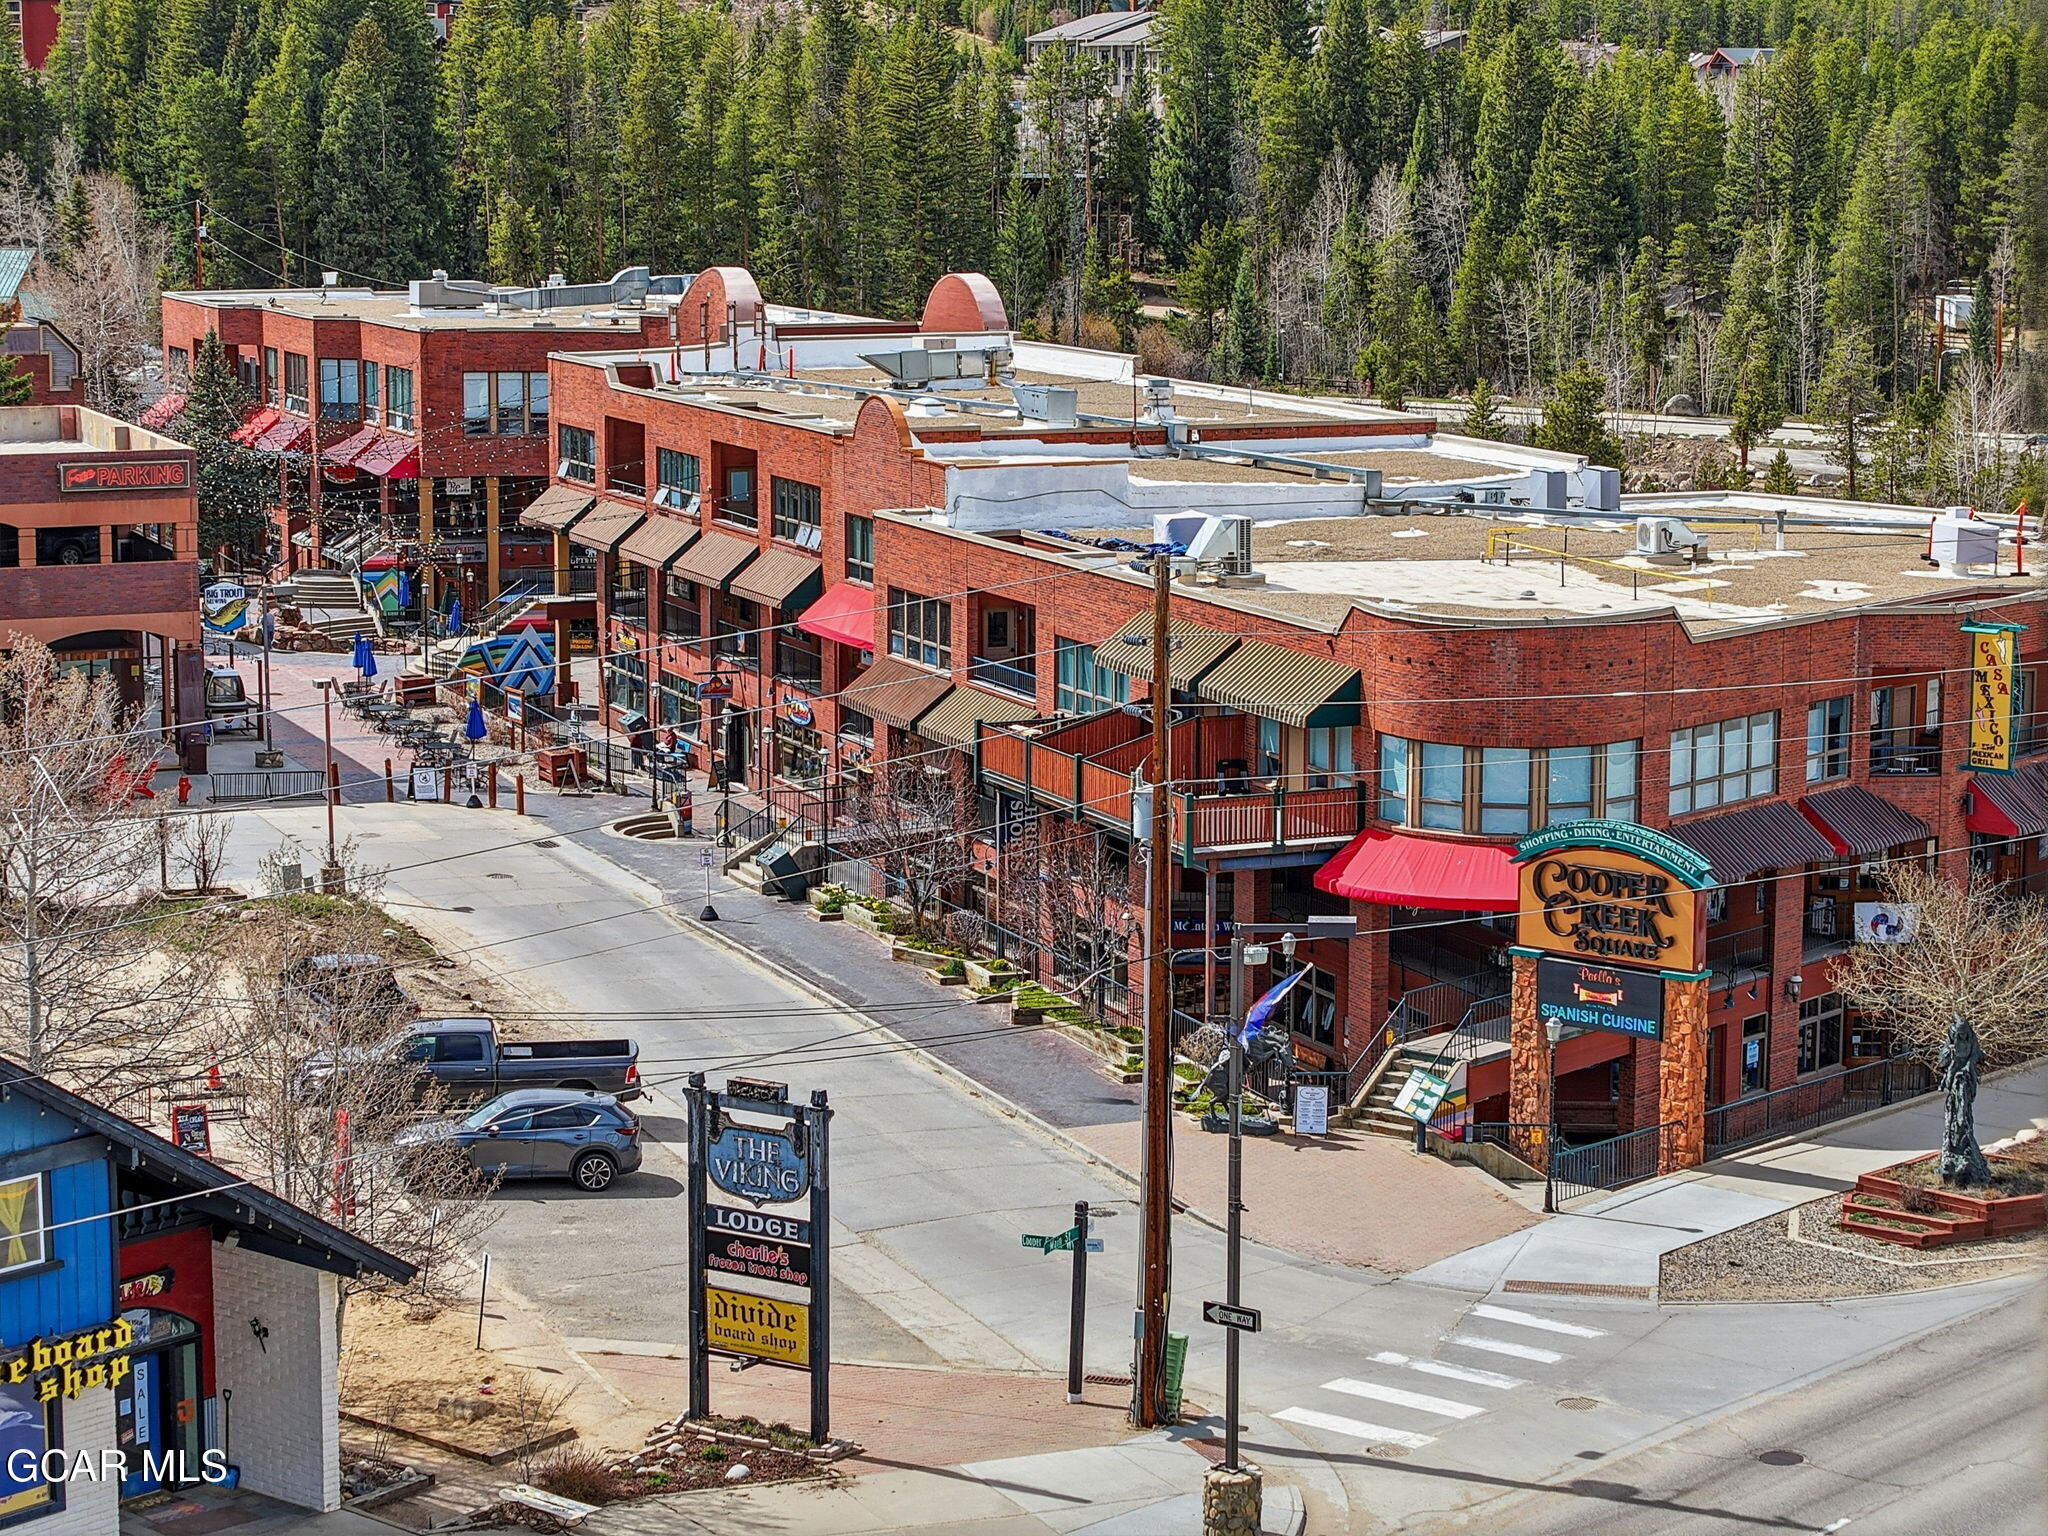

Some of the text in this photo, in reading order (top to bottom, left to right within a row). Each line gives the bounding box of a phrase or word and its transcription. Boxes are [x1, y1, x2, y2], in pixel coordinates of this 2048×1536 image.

[97, 464, 184, 485] PARKING
[206, 588, 243, 598] BIG TROUT
[1980, 641, 2009, 695] CASA
[1975, 670, 2004, 747] MEXICO
[1971, 750, 2004, 760] MEXICAN
[1971, 757, 1995, 766] GRILL
[1519, 828, 1698, 874] SHOPPING DINING ENTERTAINMENT
[1533, 860, 1675, 917] COOPER
[1544, 891, 1674, 948] CREEK
[1574, 930, 1660, 961] SQUARE
[1602, 1013, 1656, 1034] CUISINE
[733, 1136, 781, 1164] THE
[715, 1158, 799, 1193] VIKING
[715, 1208, 798, 1239] LODGE
[727, 1240, 789, 1266] charlie's
[1023, 1234, 1042, 1248] Cooper
[1049, 1238, 1063, 1249] Main
[708, 1253, 807, 1285] frozen treat shop
[714, 1293, 797, 1332] divide
[1218, 1310, 1251, 1326] ONE WAY
[714, 1322, 756, 1342] board
[761, 1332, 797, 1352] shop
[39, 1355, 131, 1402] shop
[137, 1369, 146, 1438] SALE
